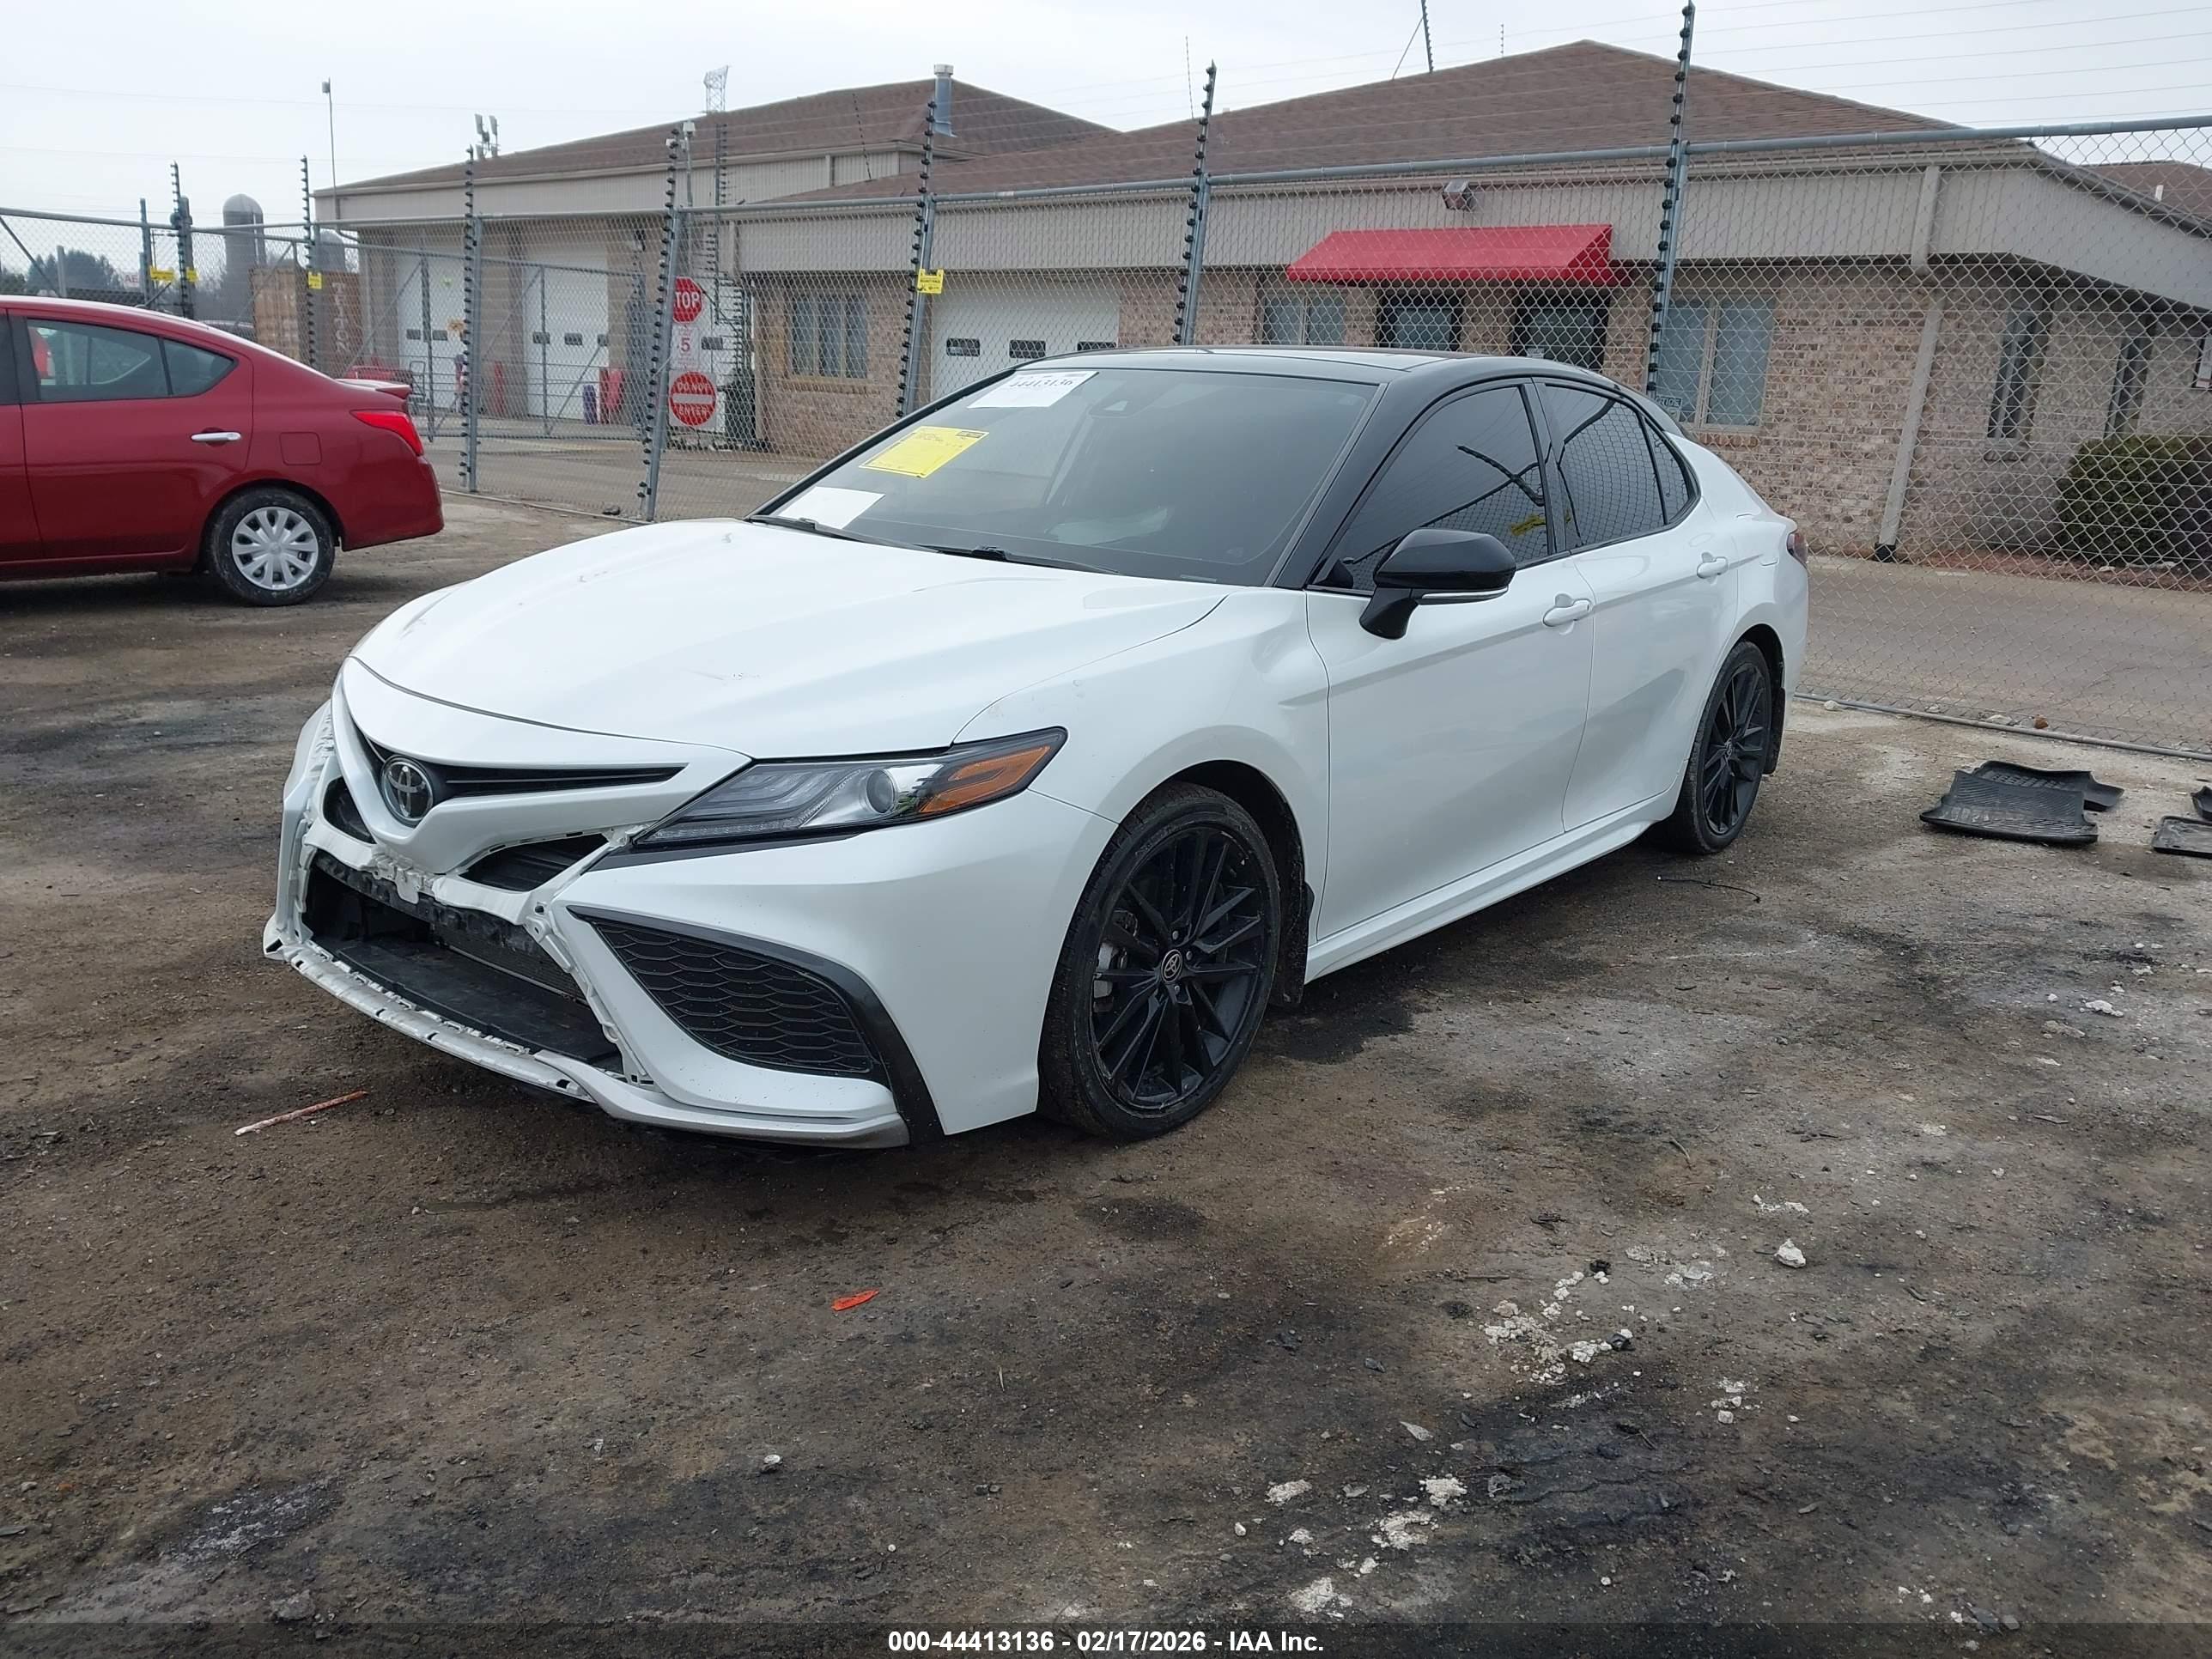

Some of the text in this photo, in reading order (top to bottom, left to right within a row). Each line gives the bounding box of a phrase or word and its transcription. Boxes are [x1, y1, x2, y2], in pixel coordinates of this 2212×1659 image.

[674, 292, 700, 309] TOP
[680, 337, 690, 353] 5
[677, 381, 710, 392] DO NOT
[678, 405, 709, 416] ENTER
